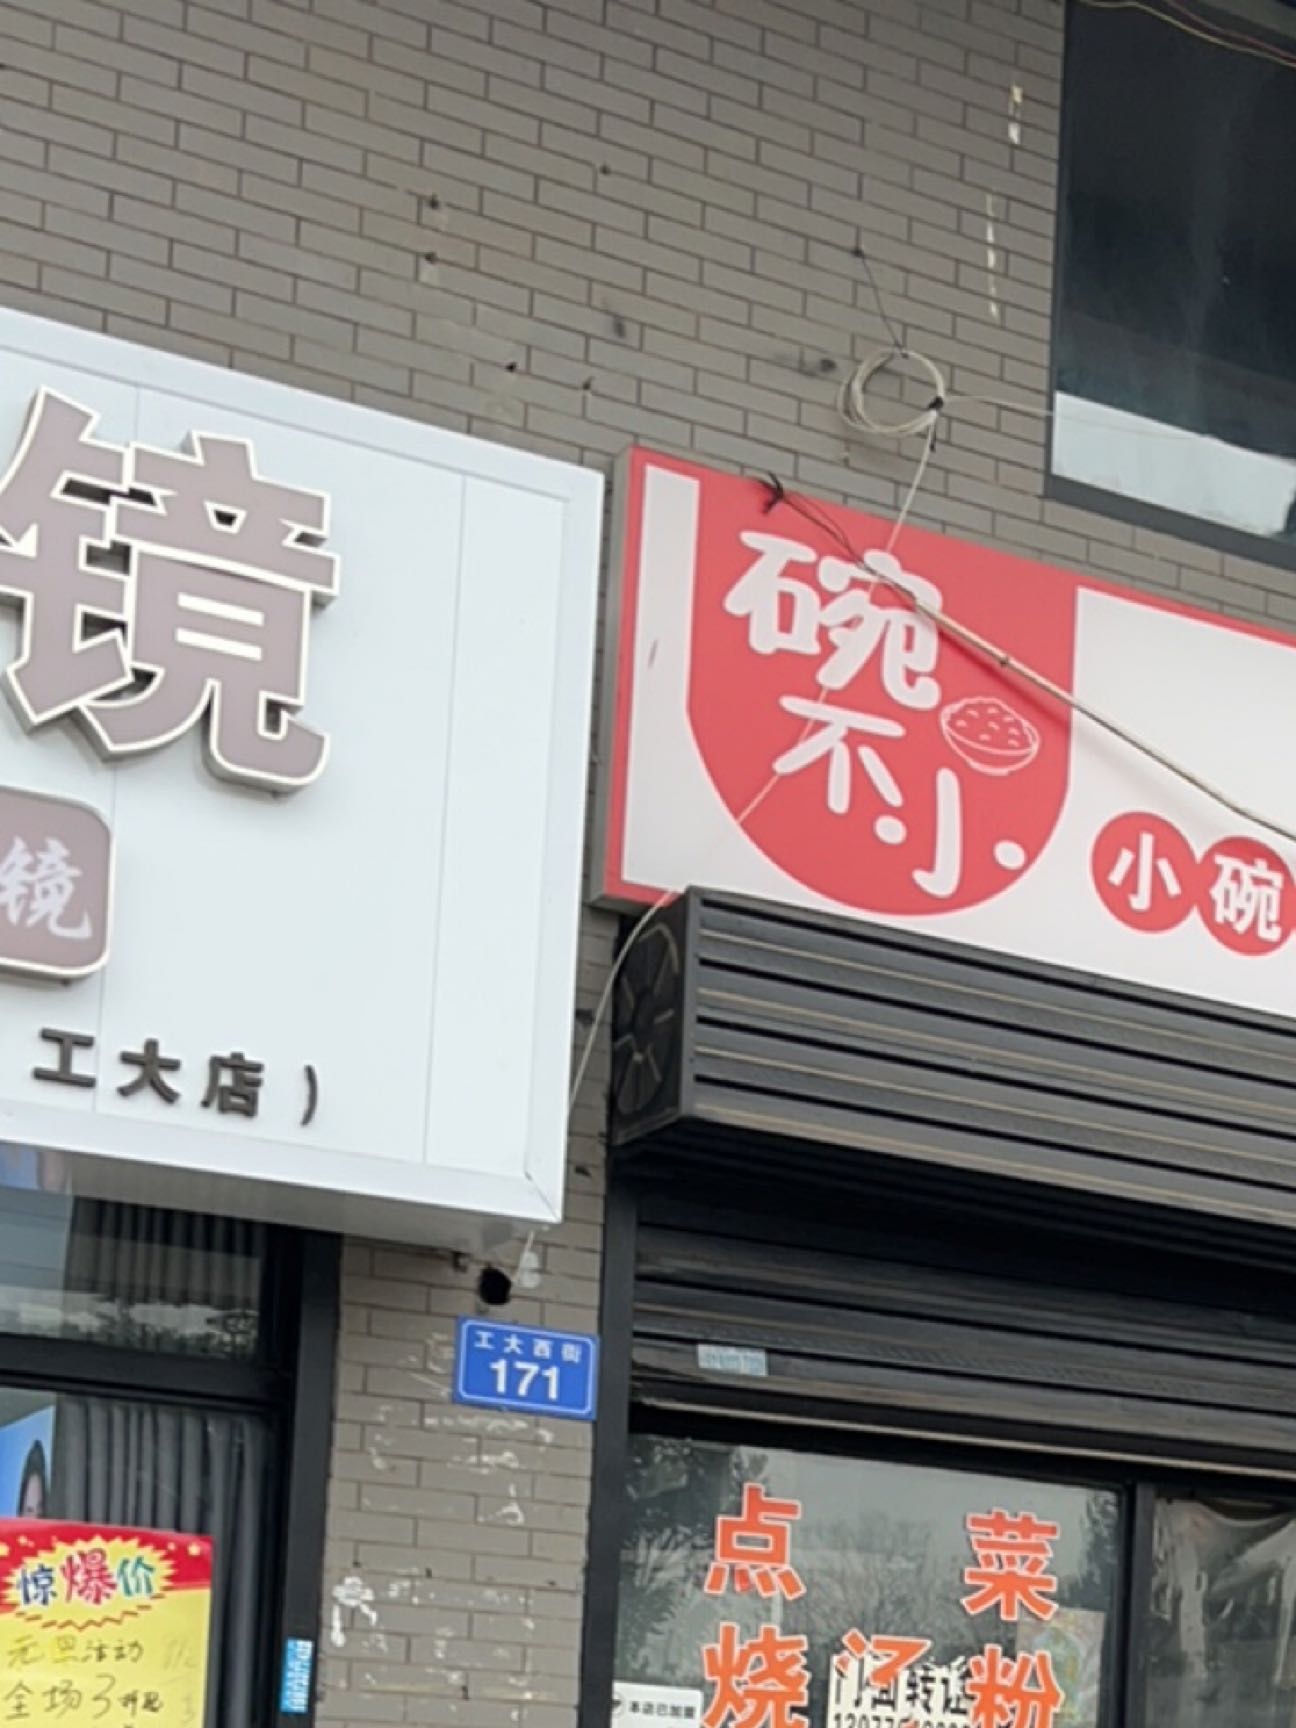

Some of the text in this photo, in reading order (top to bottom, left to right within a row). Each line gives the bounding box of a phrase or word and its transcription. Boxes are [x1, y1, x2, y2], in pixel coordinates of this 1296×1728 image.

[0, 385, 341, 797] 镜
[474, 1330, 582, 1364] 工大西街
[490, 1358, 560, 1400] 171
[17, 1548, 156, 1606] 惊爆价
